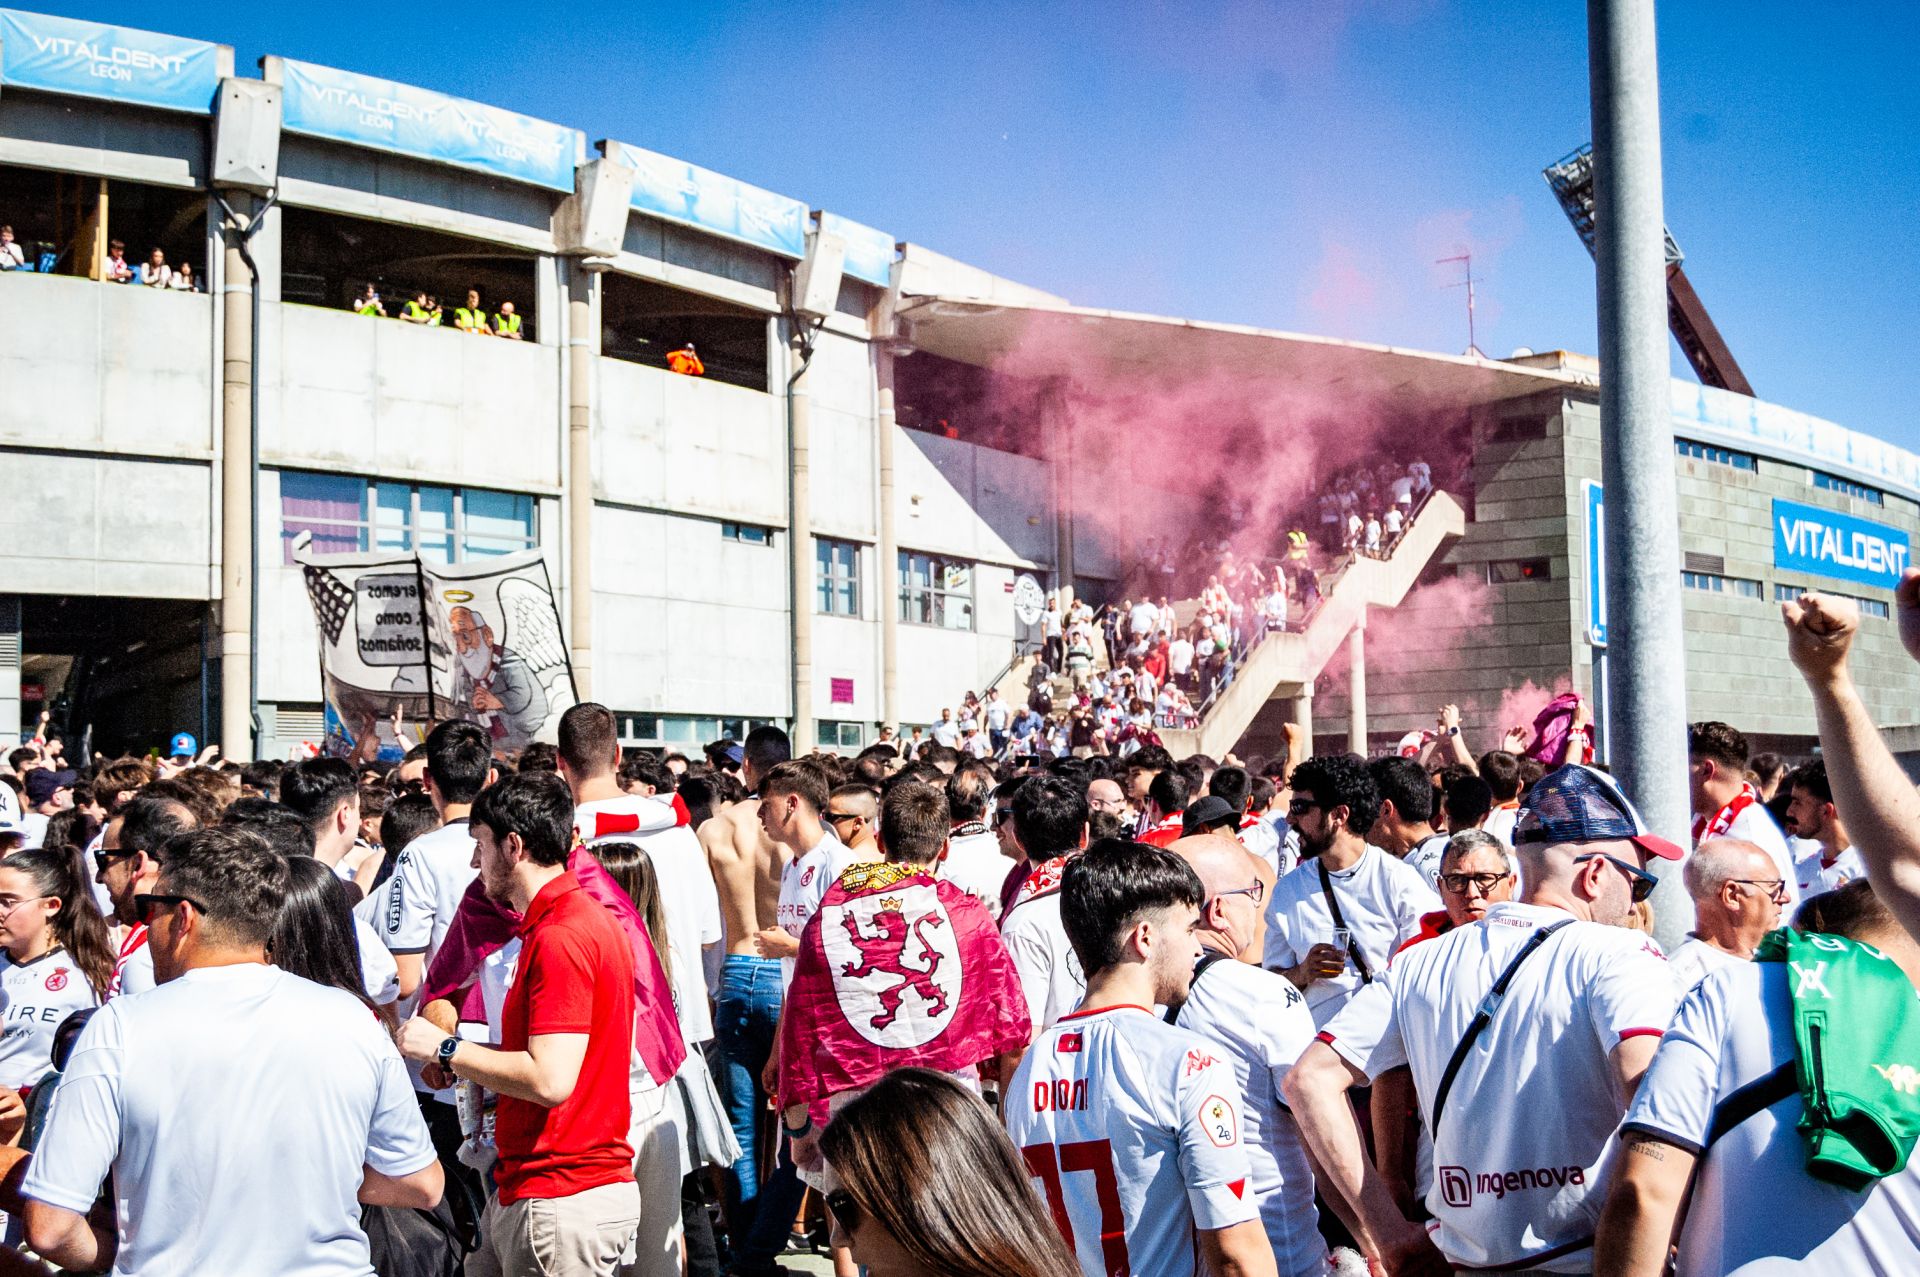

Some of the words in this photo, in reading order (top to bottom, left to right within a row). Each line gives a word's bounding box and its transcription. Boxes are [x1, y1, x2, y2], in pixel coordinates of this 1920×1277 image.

[32, 35, 188, 74] VITALDENT
[309, 85, 438, 124] VITALDENT
[1780, 515, 1907, 578] VITALDENT
[1034, 1077, 1089, 1112] DIONI
[1477, 1165, 1585, 1199] ingenova
[1021, 1138, 1131, 1277] 17
